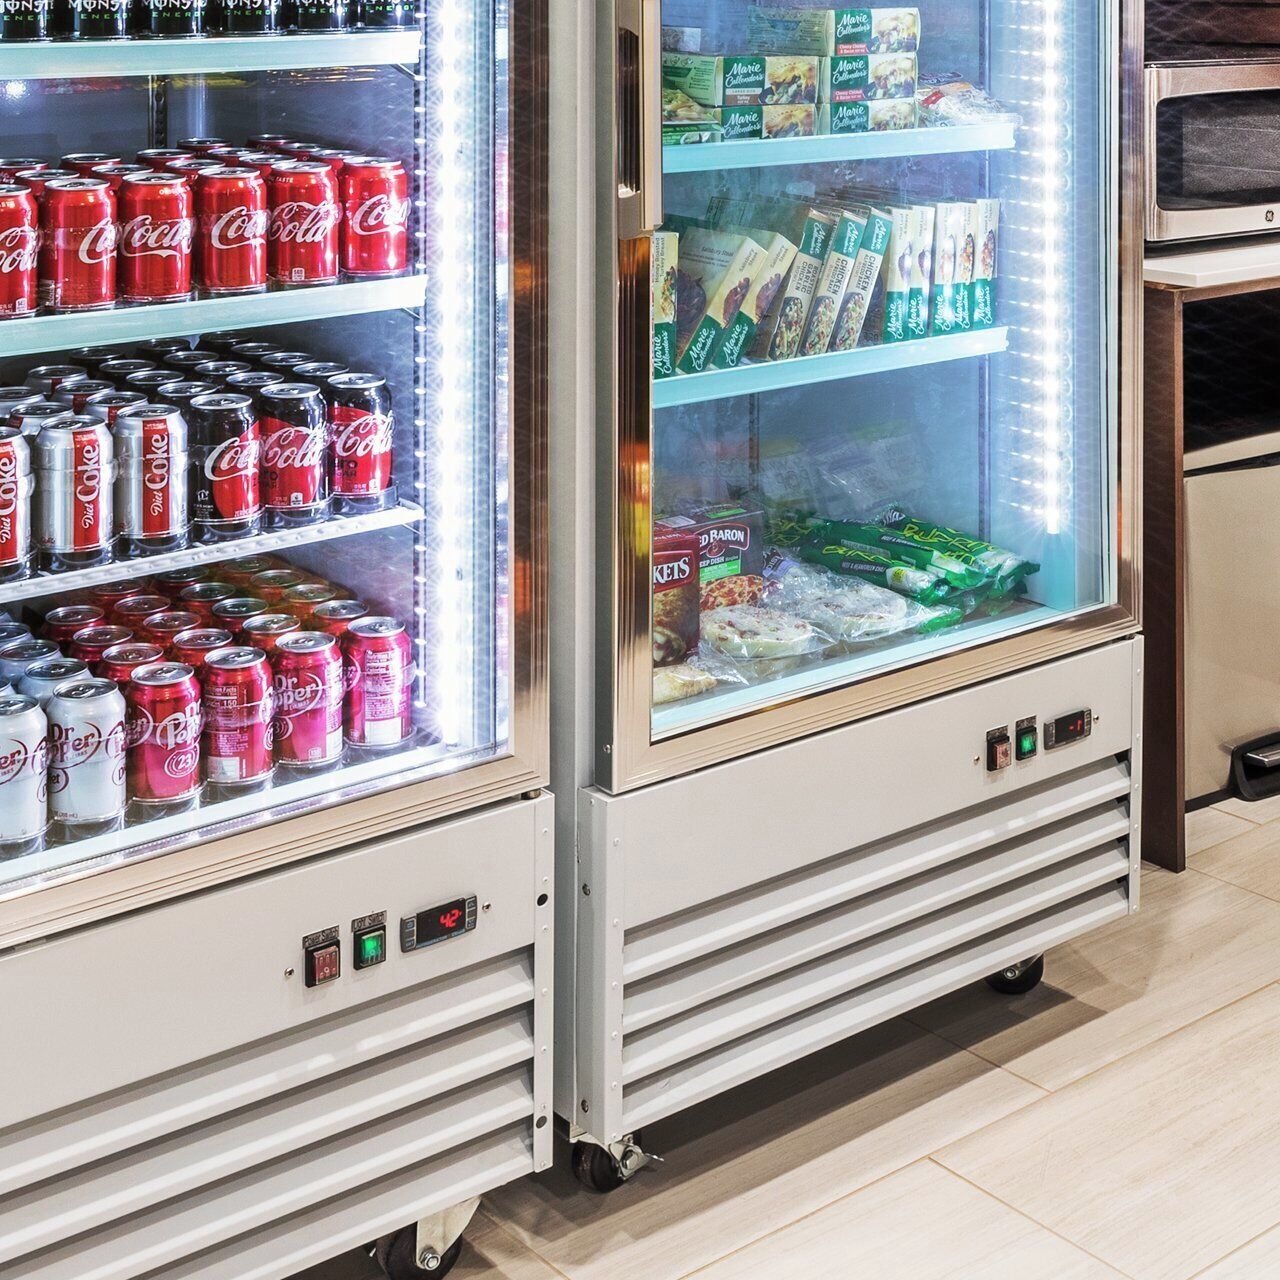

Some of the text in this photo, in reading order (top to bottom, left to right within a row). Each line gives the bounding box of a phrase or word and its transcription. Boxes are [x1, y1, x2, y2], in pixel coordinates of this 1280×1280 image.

[837, 13, 869, 28] Marie
[837, 24, 870, 38] Callender's
[725, 74, 765, 88] Callender's
[726, 62, 762, 78] Marie
[833, 59, 866, 75] Marie
[833, 71, 868, 84] Callender's
[724, 112, 759, 129] Marie
[833, 105, 866, 121] Marie
[723, 122, 762, 138] Callender's
[848, 222, 859, 254] Marie
[877, 219, 887, 251] Marie
[795, 261, 808, 291] CHICKEN
[800, 263, 814, 294] GARLIC
[832, 259, 848, 296] CHICKEN
[860, 255, 876, 292] CHICKEN
[887, 302, 897, 339] Marie
[908, 297, 918, 334] Marie
[935, 294, 944, 331] Marie
[954, 294, 964, 328] Marie
[977, 289, 986, 324] Marie
[654, 334, 664, 374] Marie
[662, 330, 672, 374] Callender's
[689, 327, 709, 367] Marie
[694, 327, 716, 371] Callender's
[723, 323, 742, 362] Marie
[728, 323, 749, 366] Callender's
[76, 442, 101, 502] Coke
[145, 432, 168, 516] Diet Coke
[82, 503, 94, 529] Diet
[710, 529, 745, 543] BARON
[710, 556, 725, 564] DISH
[275, 675, 298, 692] Dr
[178, 753, 193, 768] 23
